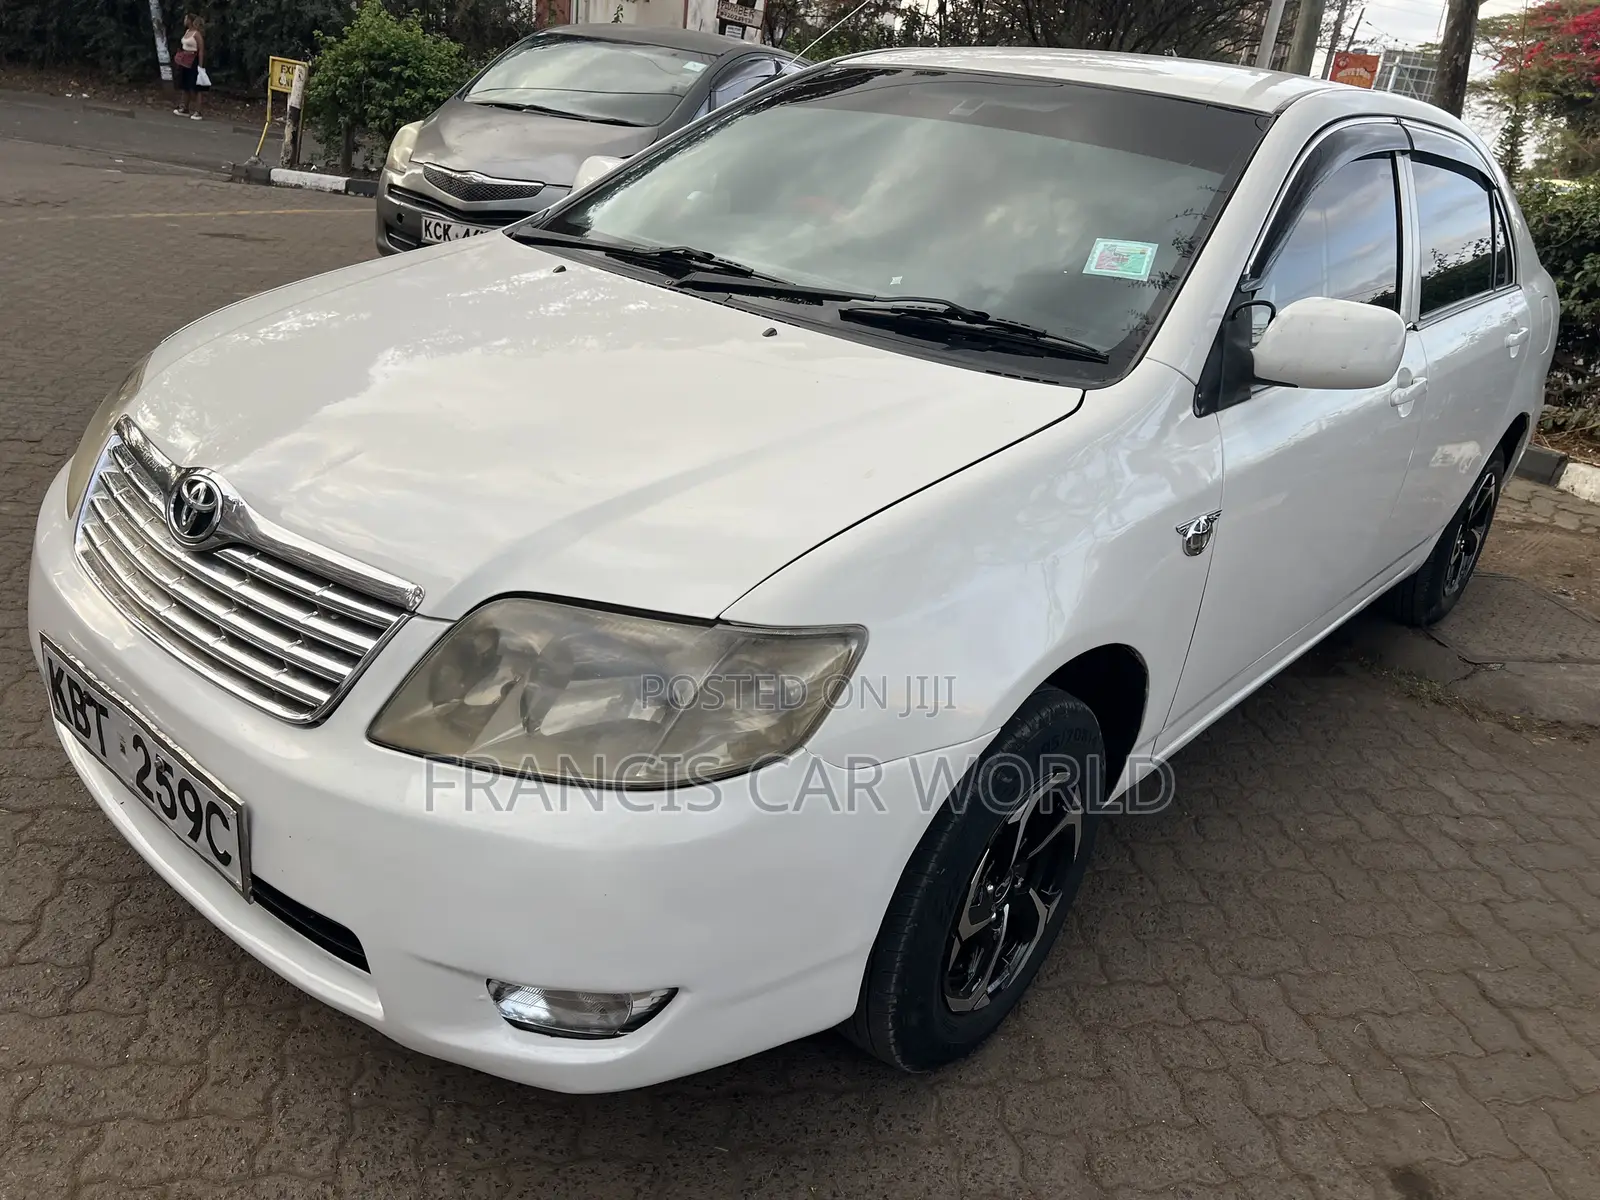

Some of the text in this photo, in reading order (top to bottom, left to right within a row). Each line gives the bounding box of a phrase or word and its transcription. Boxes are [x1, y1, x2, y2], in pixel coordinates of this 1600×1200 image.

[720, 1, 755, 19] PLUMBER
[280, 64, 297, 75] EXI
[424, 219, 452, 242] KCK
[47, 656, 232, 867] KBT 259C
